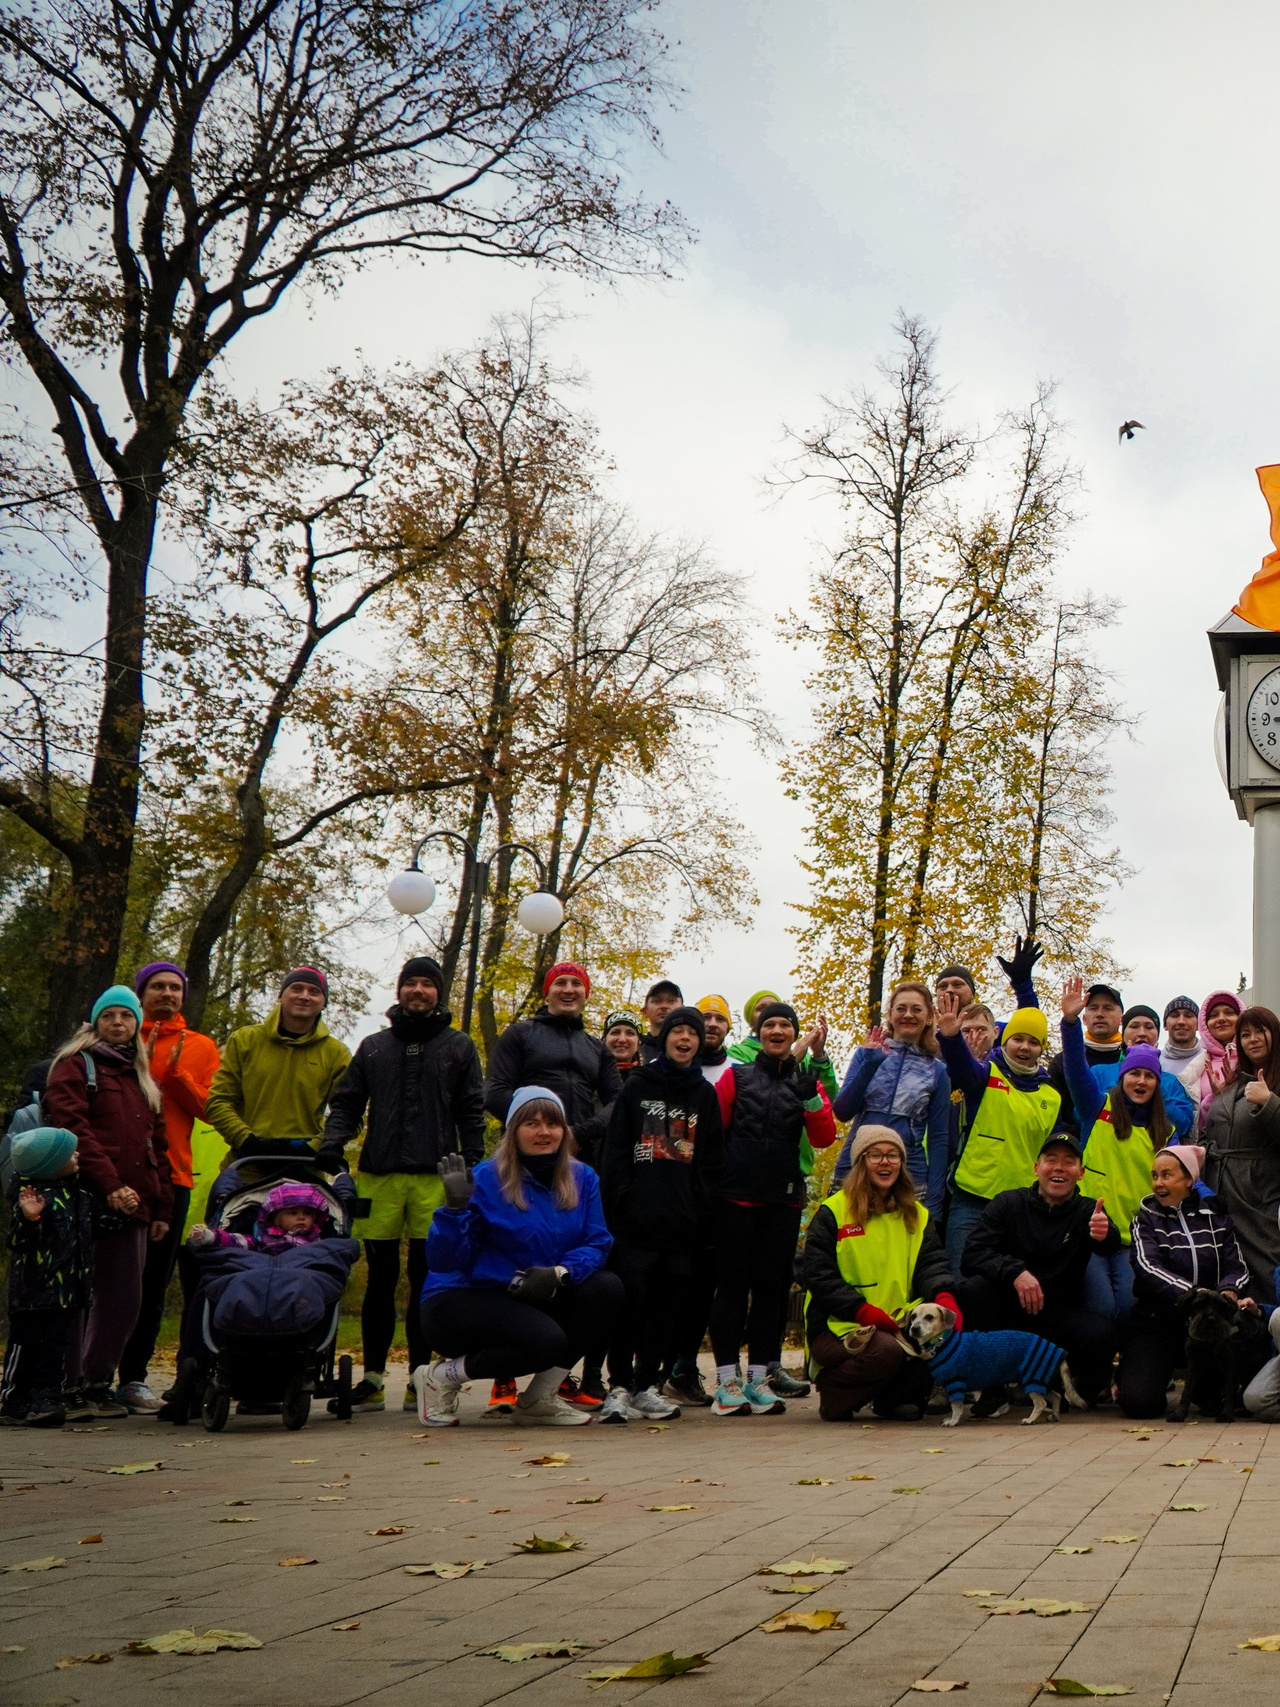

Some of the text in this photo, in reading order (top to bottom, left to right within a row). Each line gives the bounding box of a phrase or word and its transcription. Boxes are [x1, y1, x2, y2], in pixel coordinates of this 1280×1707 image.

[1265, 691, 1279, 706] 10
[1261, 712, 1271, 726] 9
[1267, 731, 1277, 746] 8
